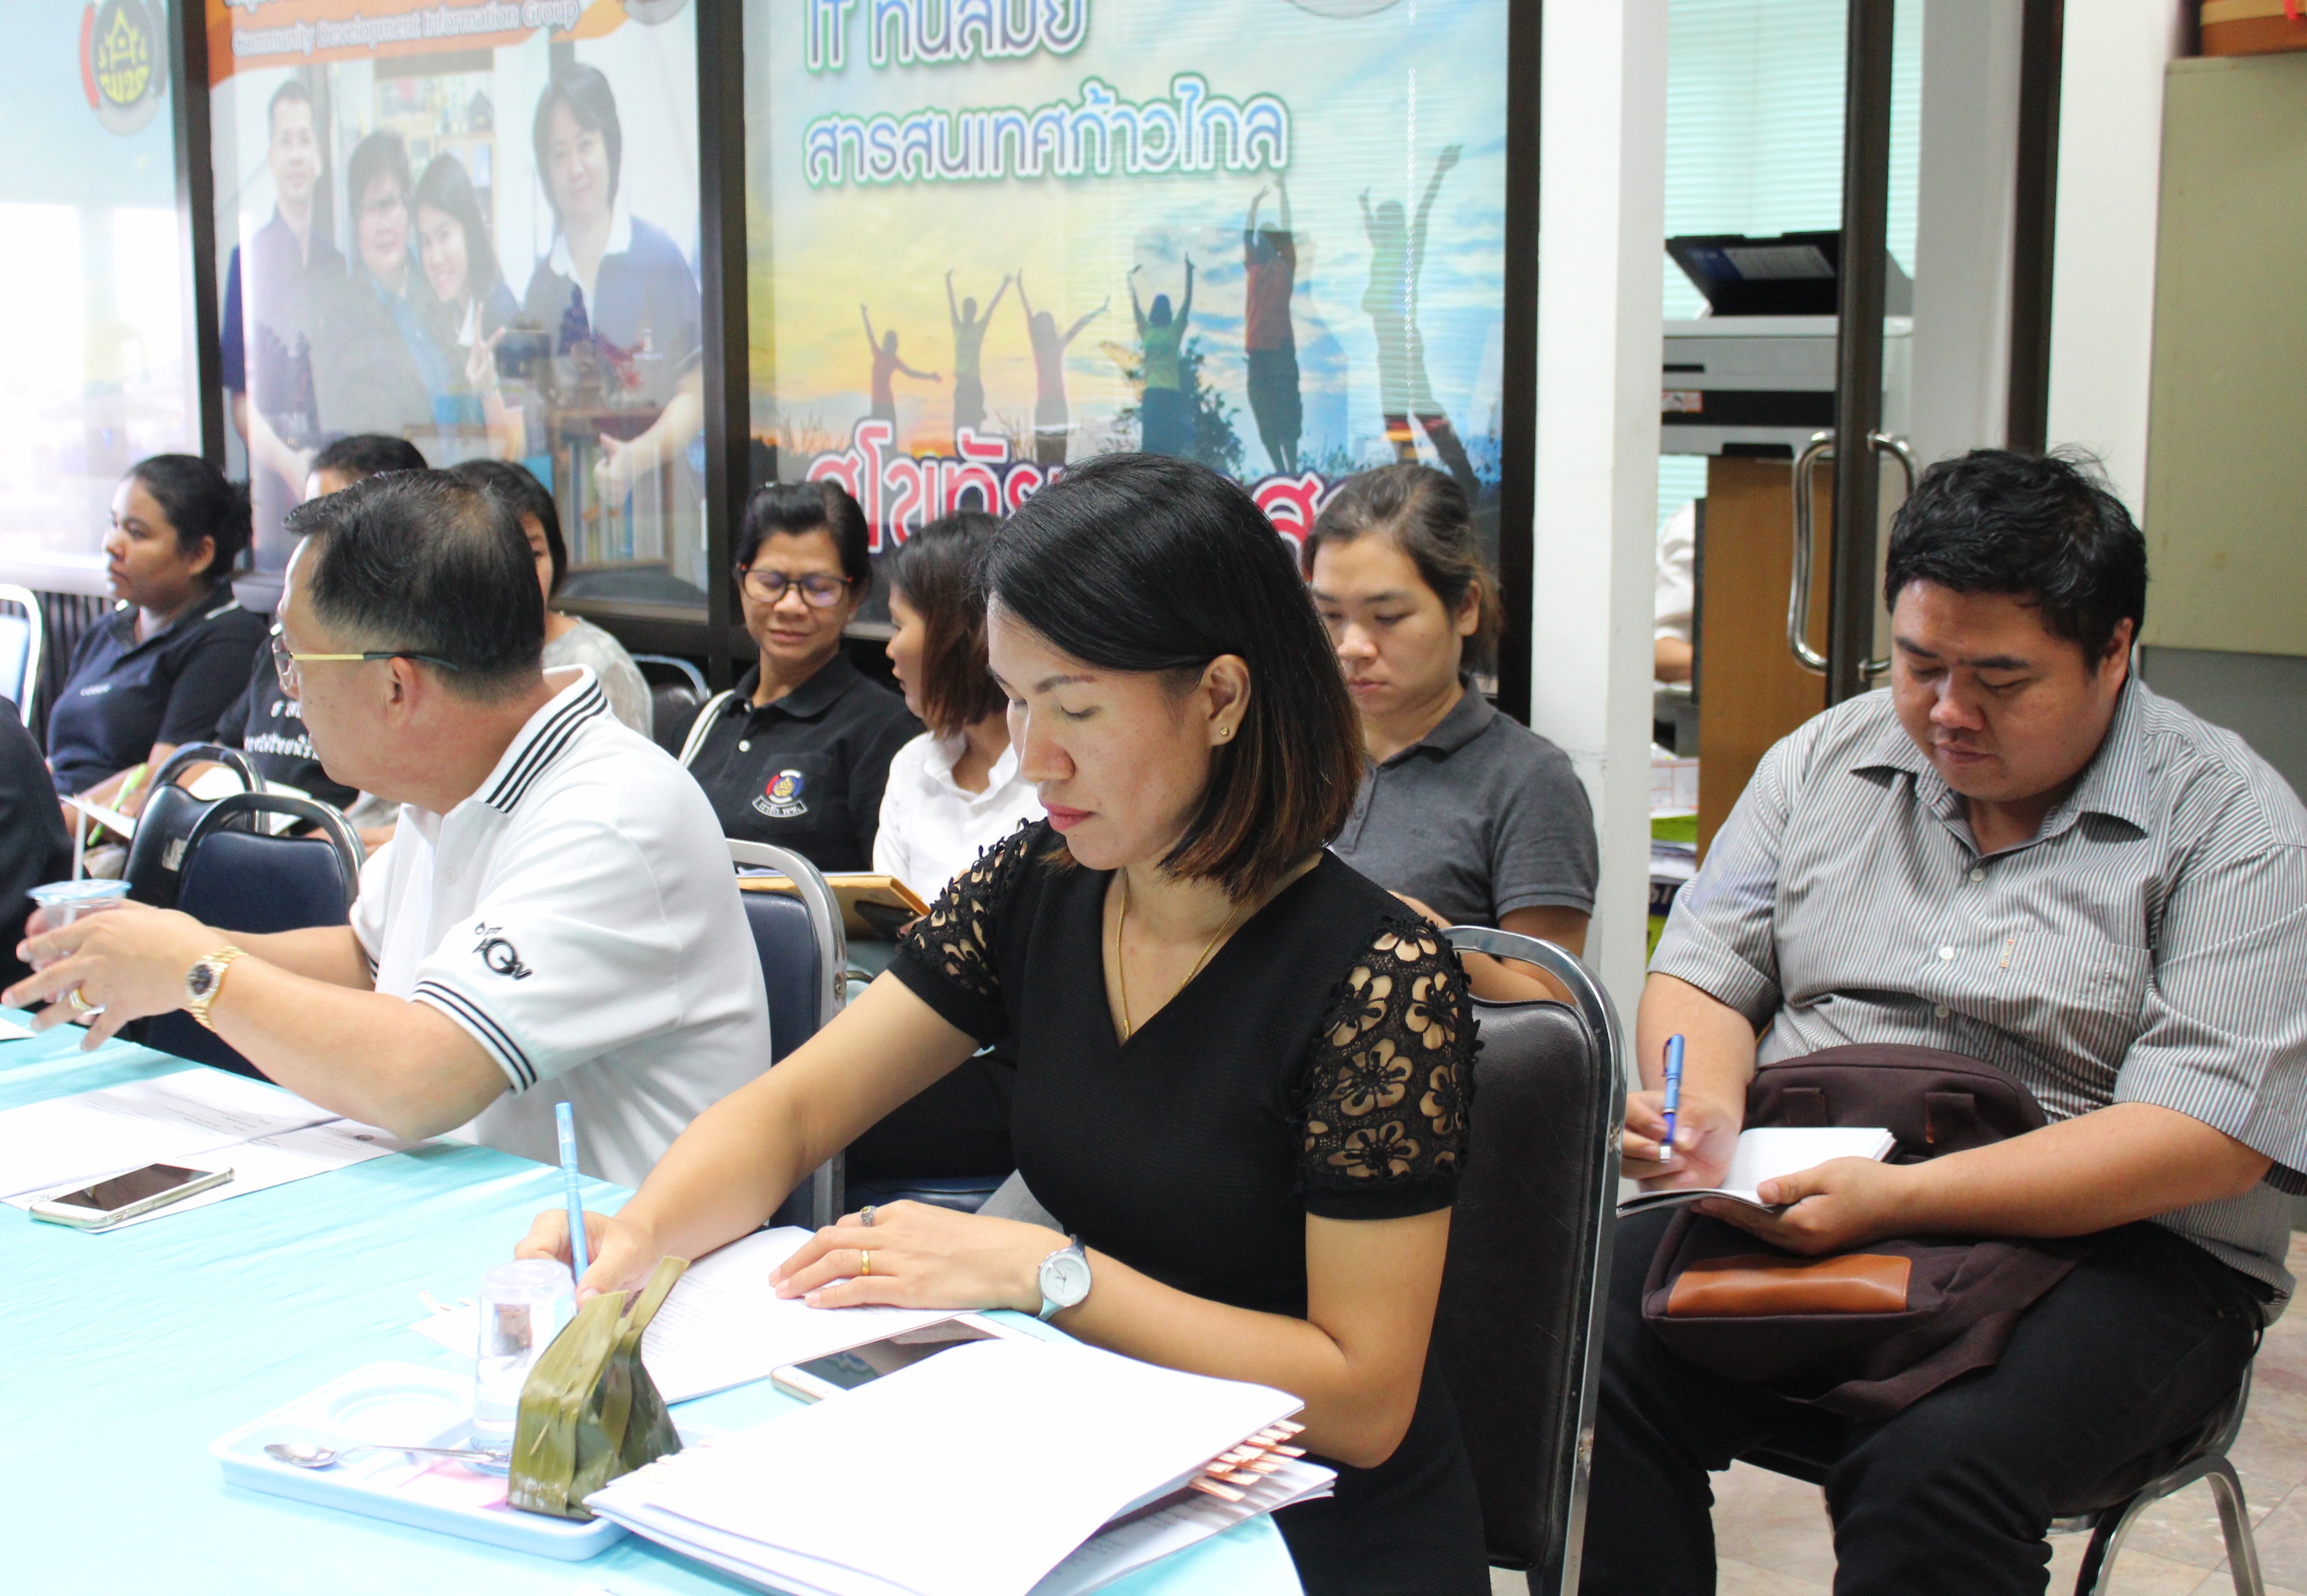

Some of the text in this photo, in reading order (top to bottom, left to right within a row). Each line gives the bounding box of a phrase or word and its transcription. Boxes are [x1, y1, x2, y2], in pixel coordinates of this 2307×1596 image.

[232, 0, 580, 57] Community Development Information Group
[804, 76, 1289, 183] สารสนเทศก้าวไกล
